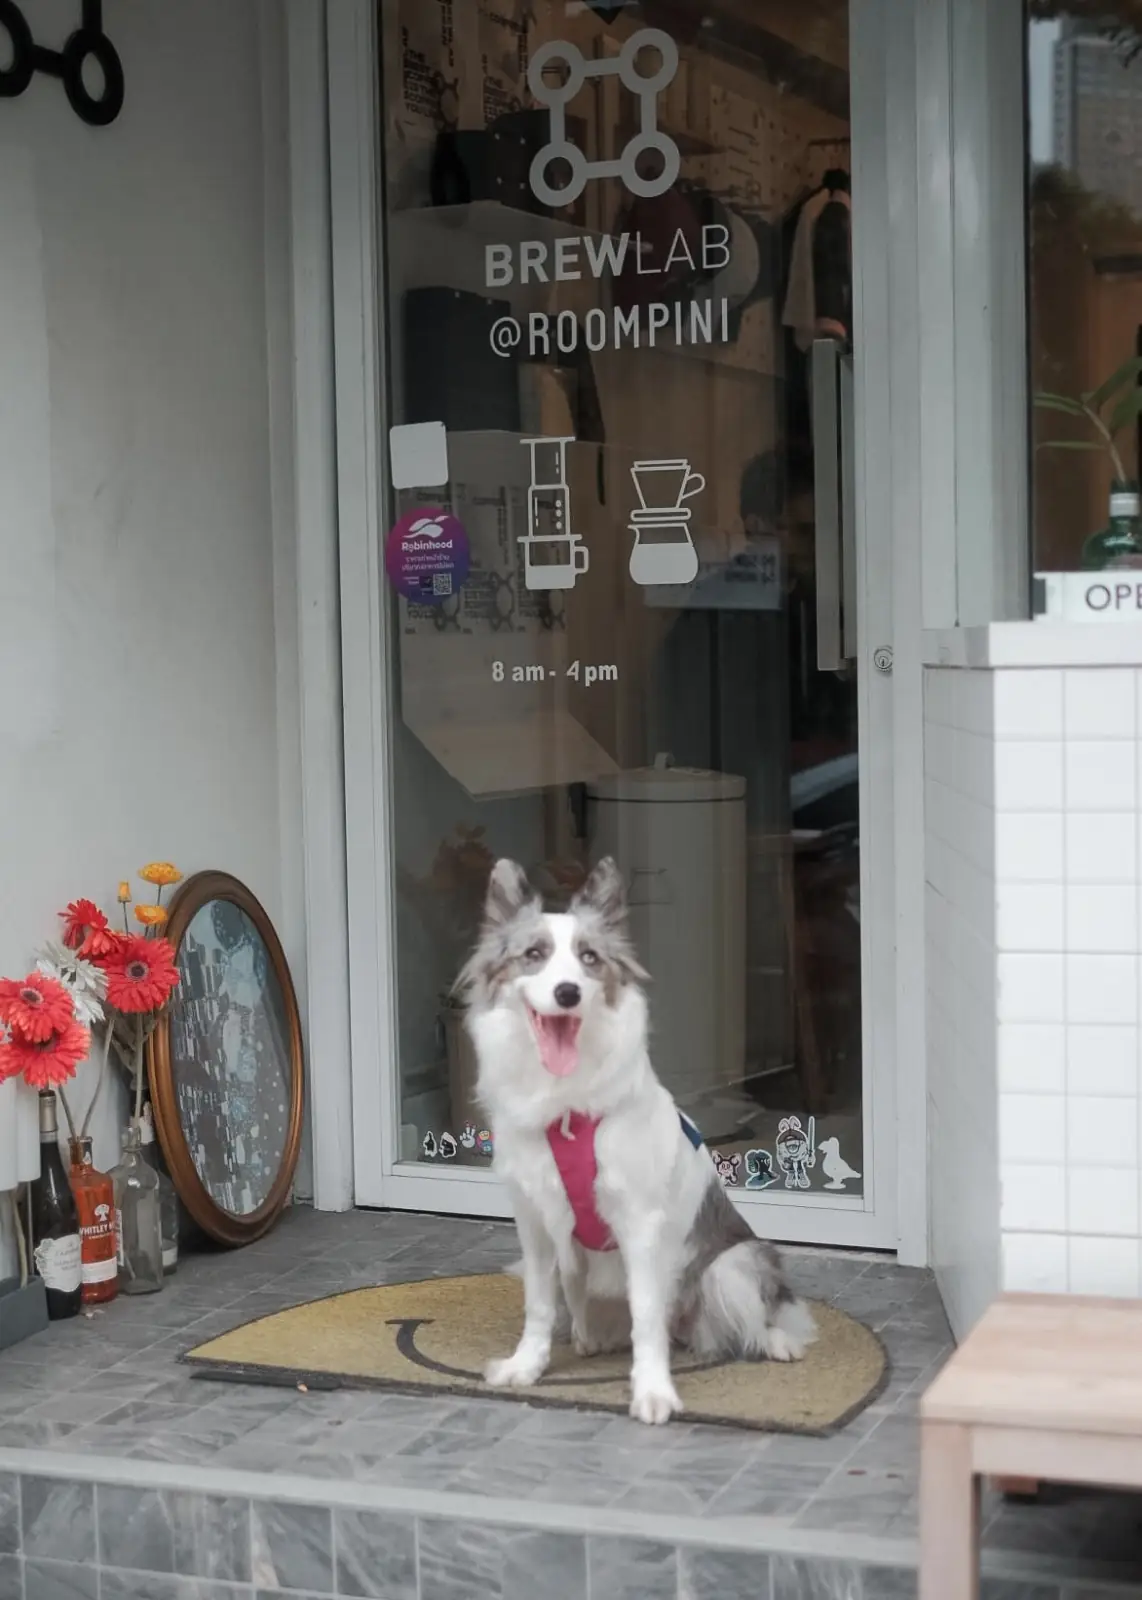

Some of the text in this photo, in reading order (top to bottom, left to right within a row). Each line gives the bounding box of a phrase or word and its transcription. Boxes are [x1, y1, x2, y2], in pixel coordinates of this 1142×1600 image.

[485, 224, 731, 287] BREWLAB
[489, 297, 730, 358] @ROOMPINI
[401, 539, 453, 552] Robinhood
[491, 660, 505, 683] 8
[566, 660, 580, 682] 4
[584, 664, 618, 687] pm
